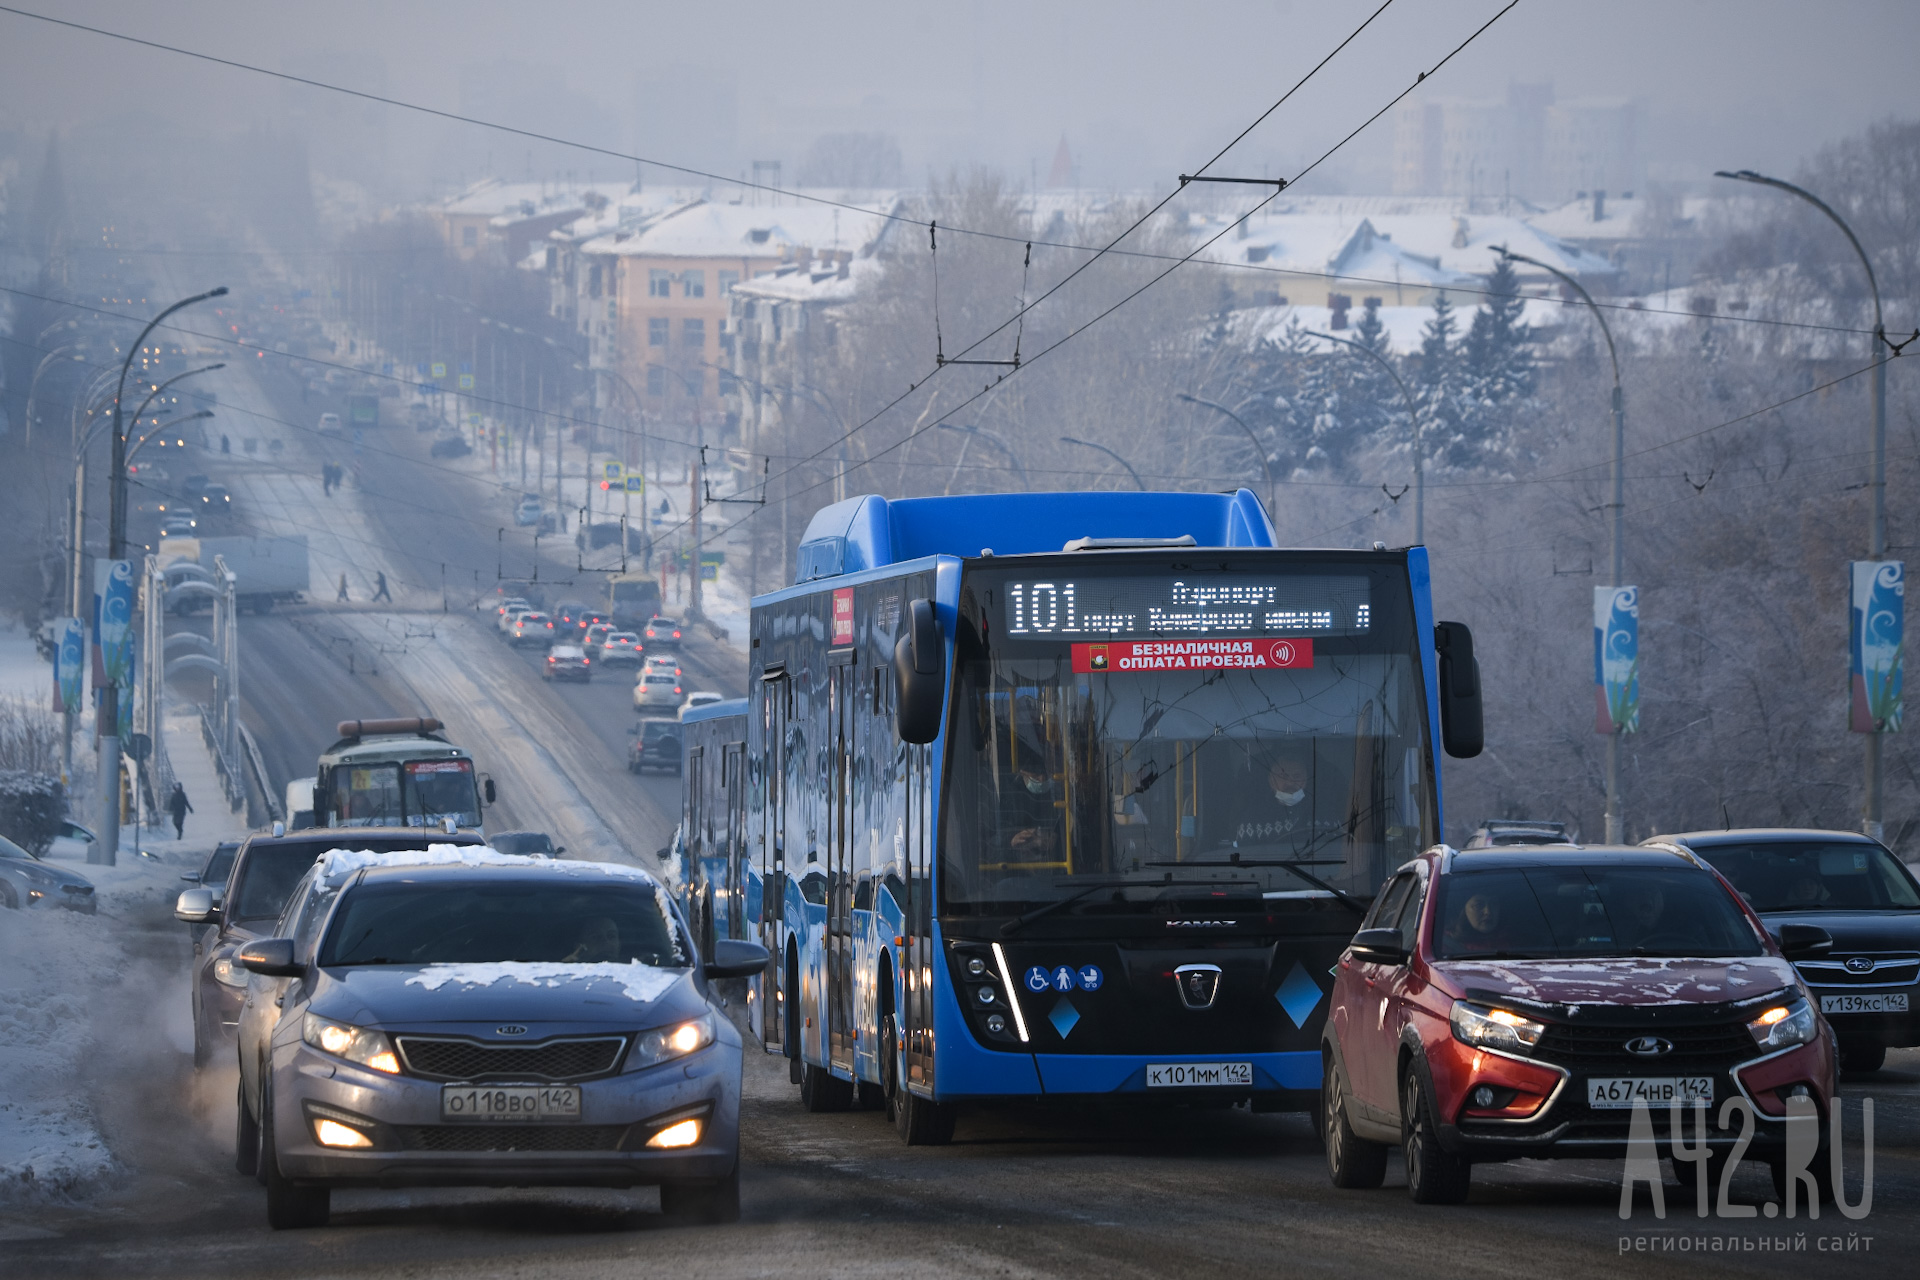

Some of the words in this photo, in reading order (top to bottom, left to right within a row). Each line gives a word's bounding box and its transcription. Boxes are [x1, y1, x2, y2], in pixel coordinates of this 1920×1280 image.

[1009, 583, 1081, 633] 101
[1132, 641, 1253, 656] БЕЗНАЛИЧНАЯ
[1118, 656, 1187, 669] ОПЛАТА
[1189, 654, 1267, 669] ПРОЕЗДА
[1165, 920, 1238, 928] KAMAZ
[1883, 994, 1905, 1007] 142
[501, 1026, 522, 1034] KIA
[1152, 1065, 1219, 1084] К101ММ
[1222, 1064, 1248, 1078] 142
[1679, 1078, 1709, 1094] 142
[540, 1089, 573, 1107] 142
